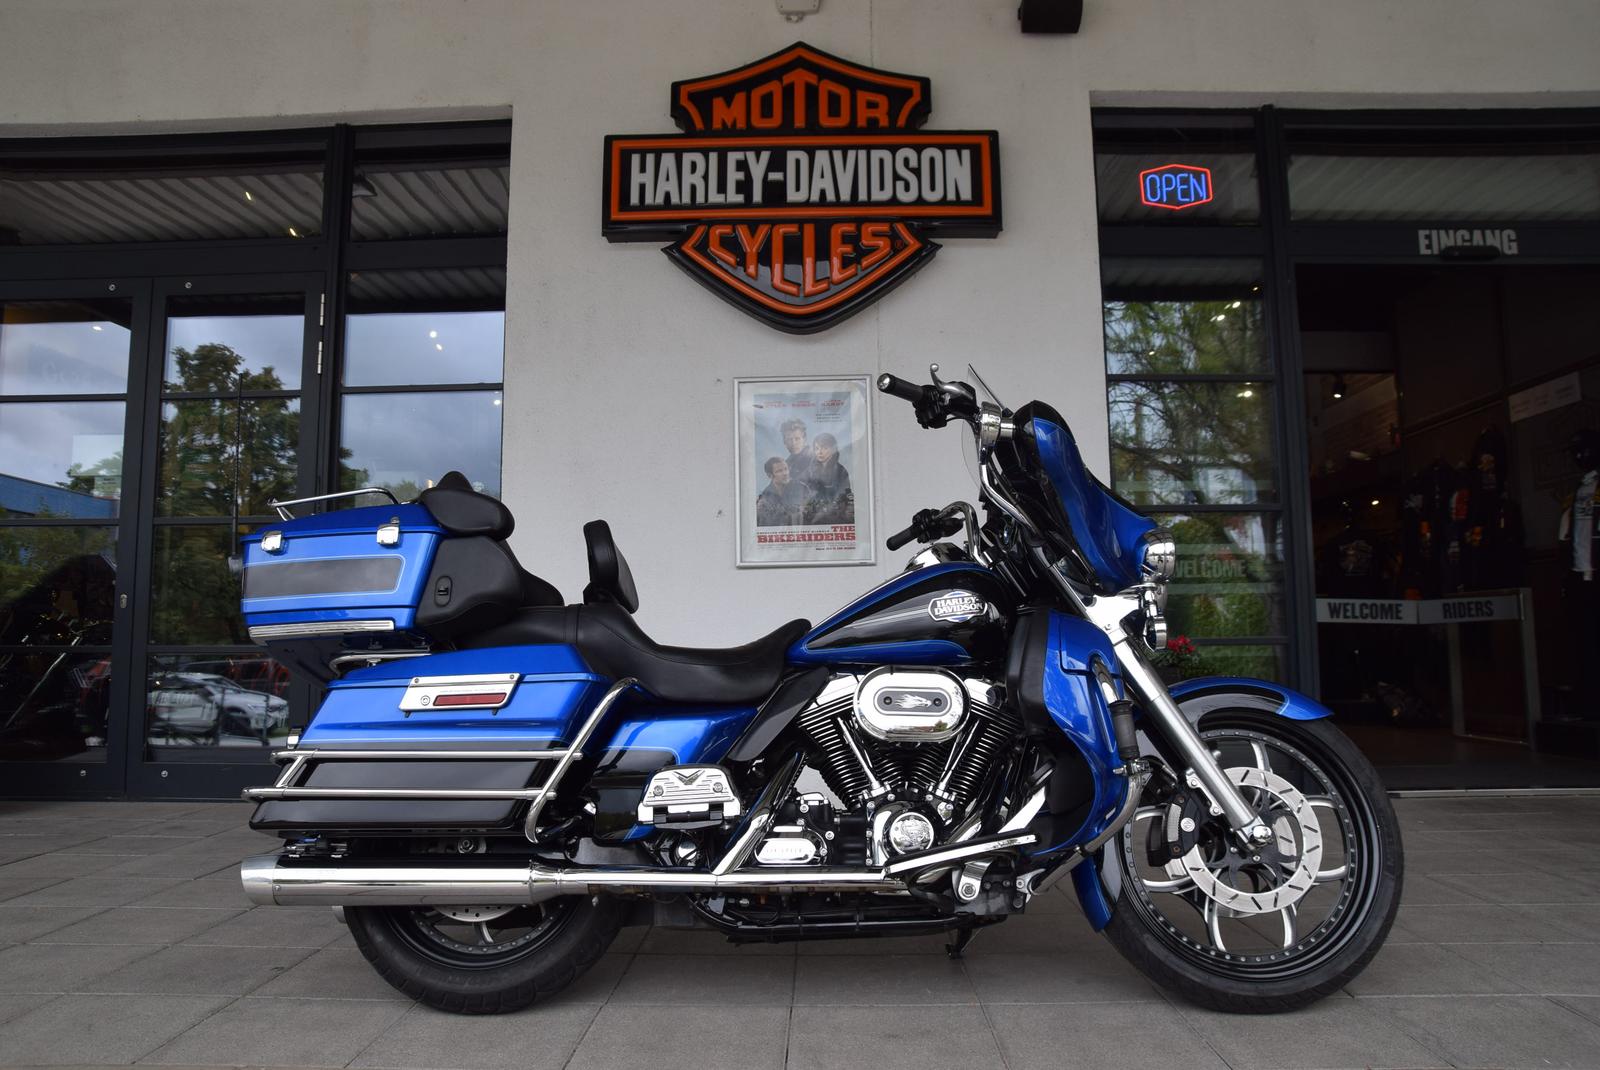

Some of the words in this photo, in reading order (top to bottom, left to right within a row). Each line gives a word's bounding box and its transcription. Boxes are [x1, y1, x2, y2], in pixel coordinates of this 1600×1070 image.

[712, 67, 890, 129] MOTOR
[629, 147, 973, 206] HARLEY-DAVIDSON
[1145, 172, 1207, 203] OPEN
[1418, 229, 1519, 255] EINGANG
[708, 222, 893, 298] CYCLES
[757, 533, 856, 544] BIKERIDERS
[831, 525, 856, 533] THE
[934, 603, 983, 615] DAVIDSON
[1327, 602, 1404, 620] WELCOME
[1442, 600, 1494, 619] RIDERS
